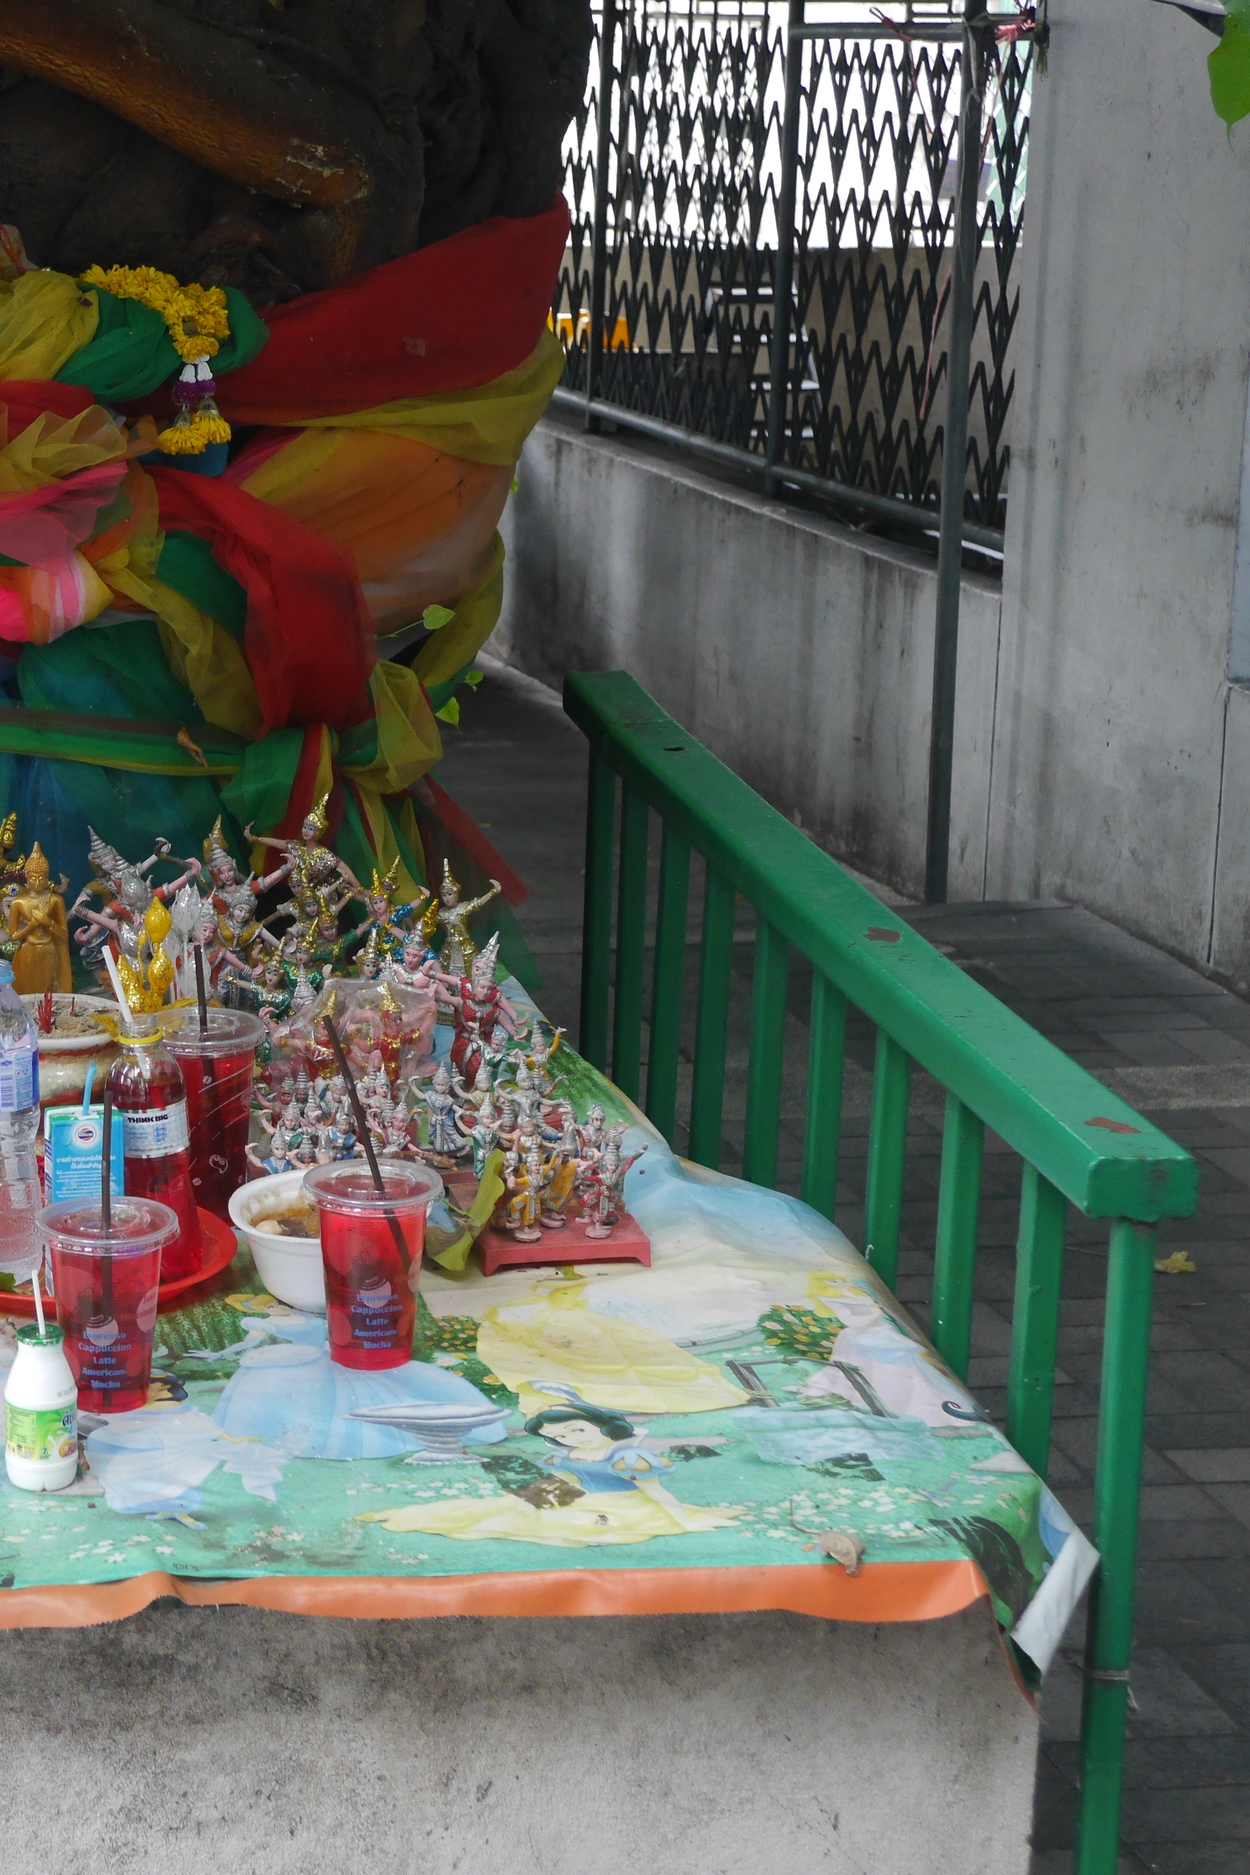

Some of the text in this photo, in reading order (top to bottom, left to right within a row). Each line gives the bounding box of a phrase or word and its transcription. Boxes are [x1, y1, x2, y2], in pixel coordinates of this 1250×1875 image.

[155, 1114, 169, 1122] BIG
[351, 1304, 403, 1314] Cappuccino
[366, 1318, 388, 1326] Latte
[78, 1342, 132, 1353] Cappuccino
[363, 1341, 391, 1349] Mocha
[93, 1356, 116, 1364] Latte
[91, 1379, 120, 1389] Mocha
